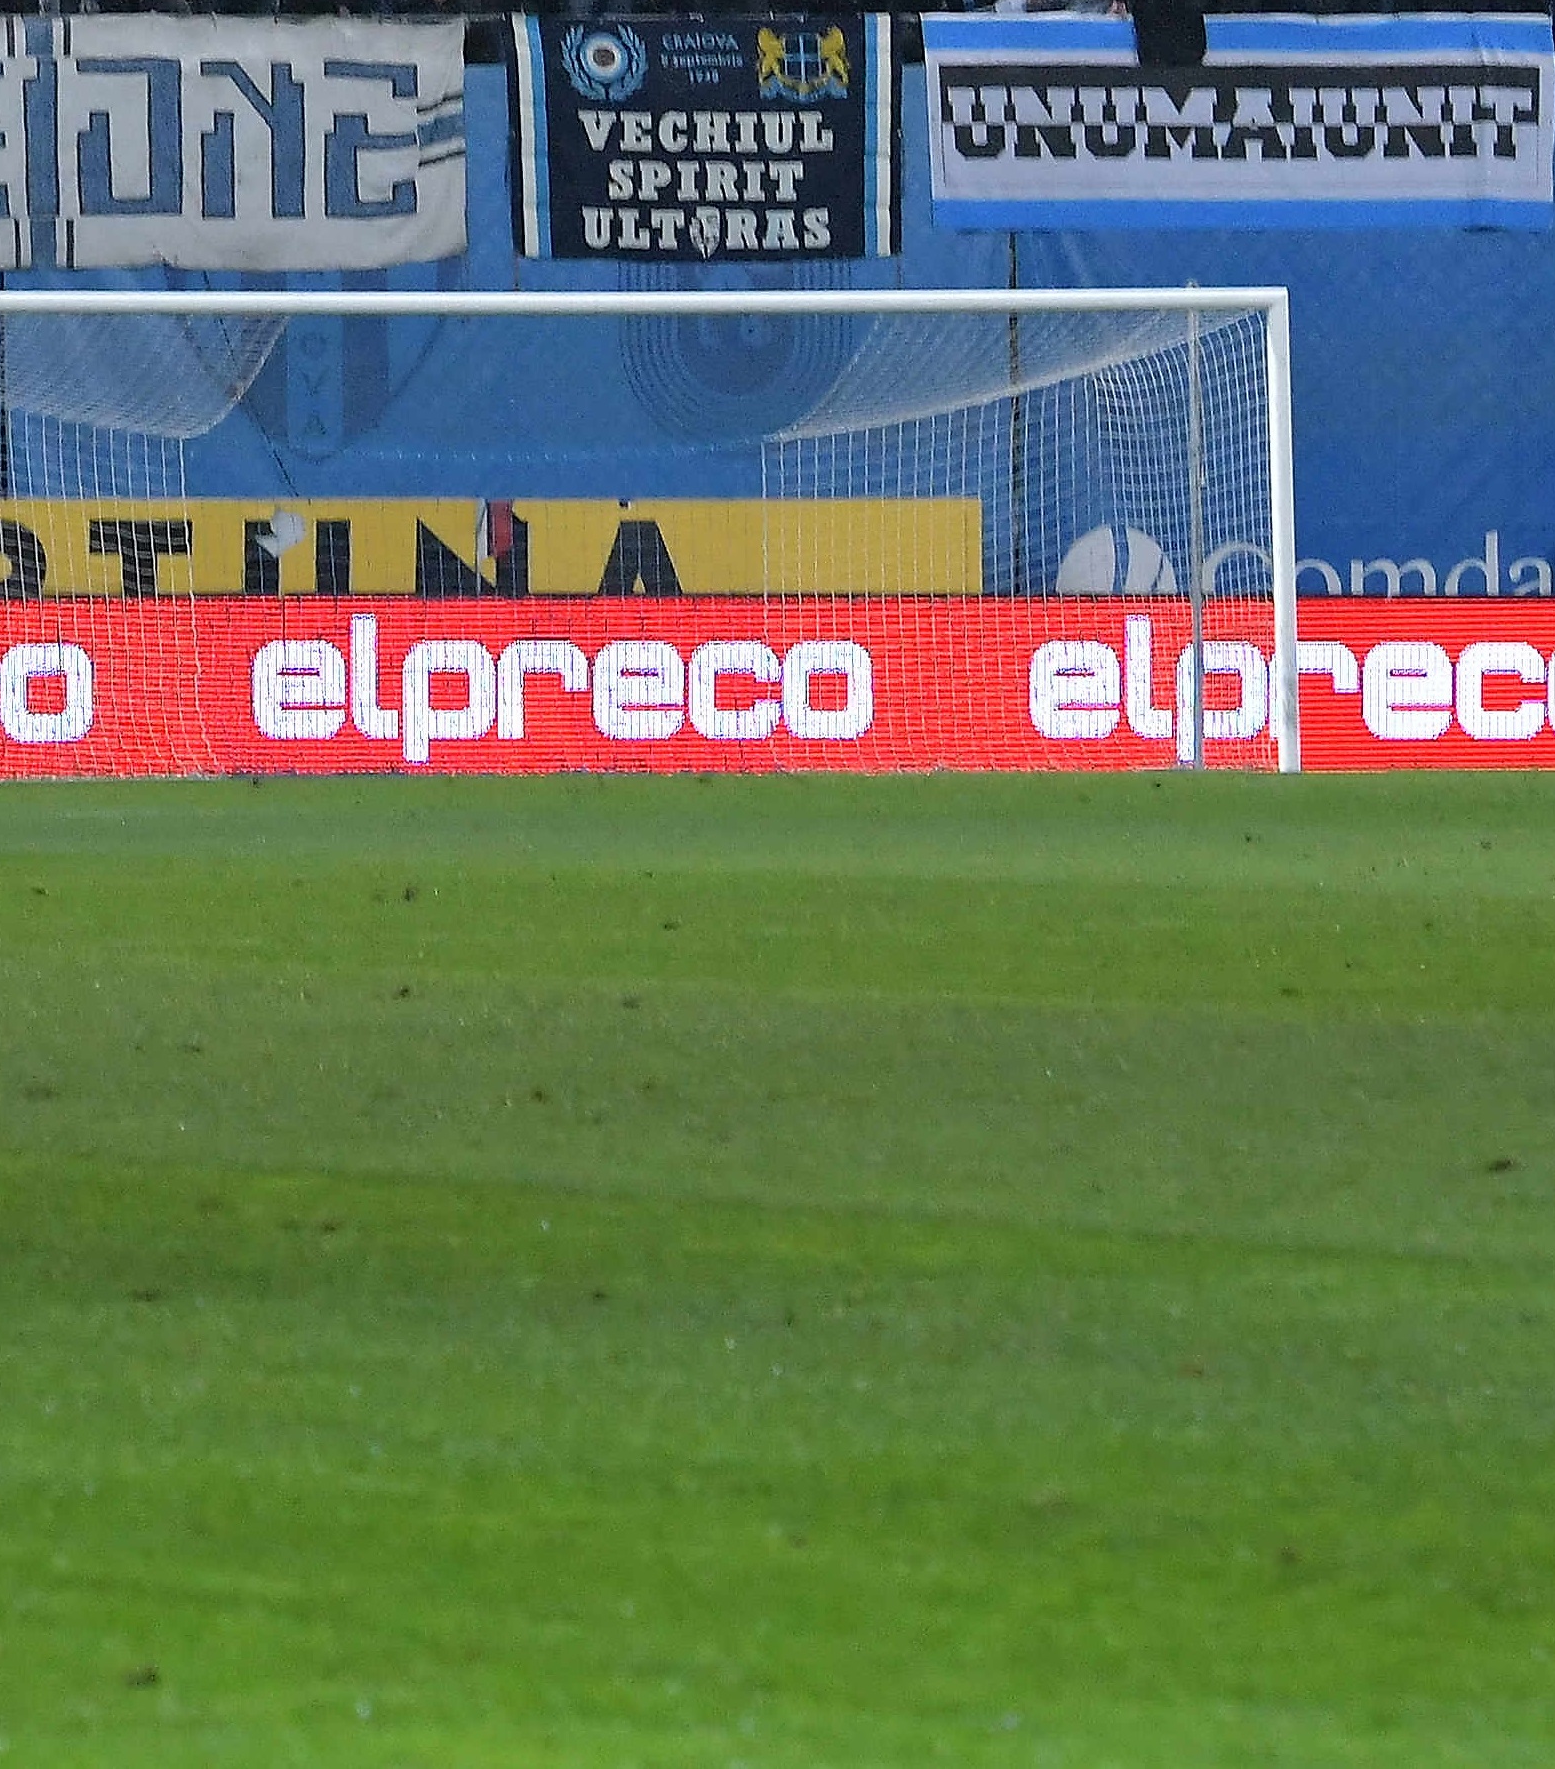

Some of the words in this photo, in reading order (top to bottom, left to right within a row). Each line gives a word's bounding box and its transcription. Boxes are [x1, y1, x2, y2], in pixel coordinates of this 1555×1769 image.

[578, 109, 834, 154] VECHIUL
[607, 159, 804, 202] SPIRIT
[251, 612, 874, 765] elpreco
